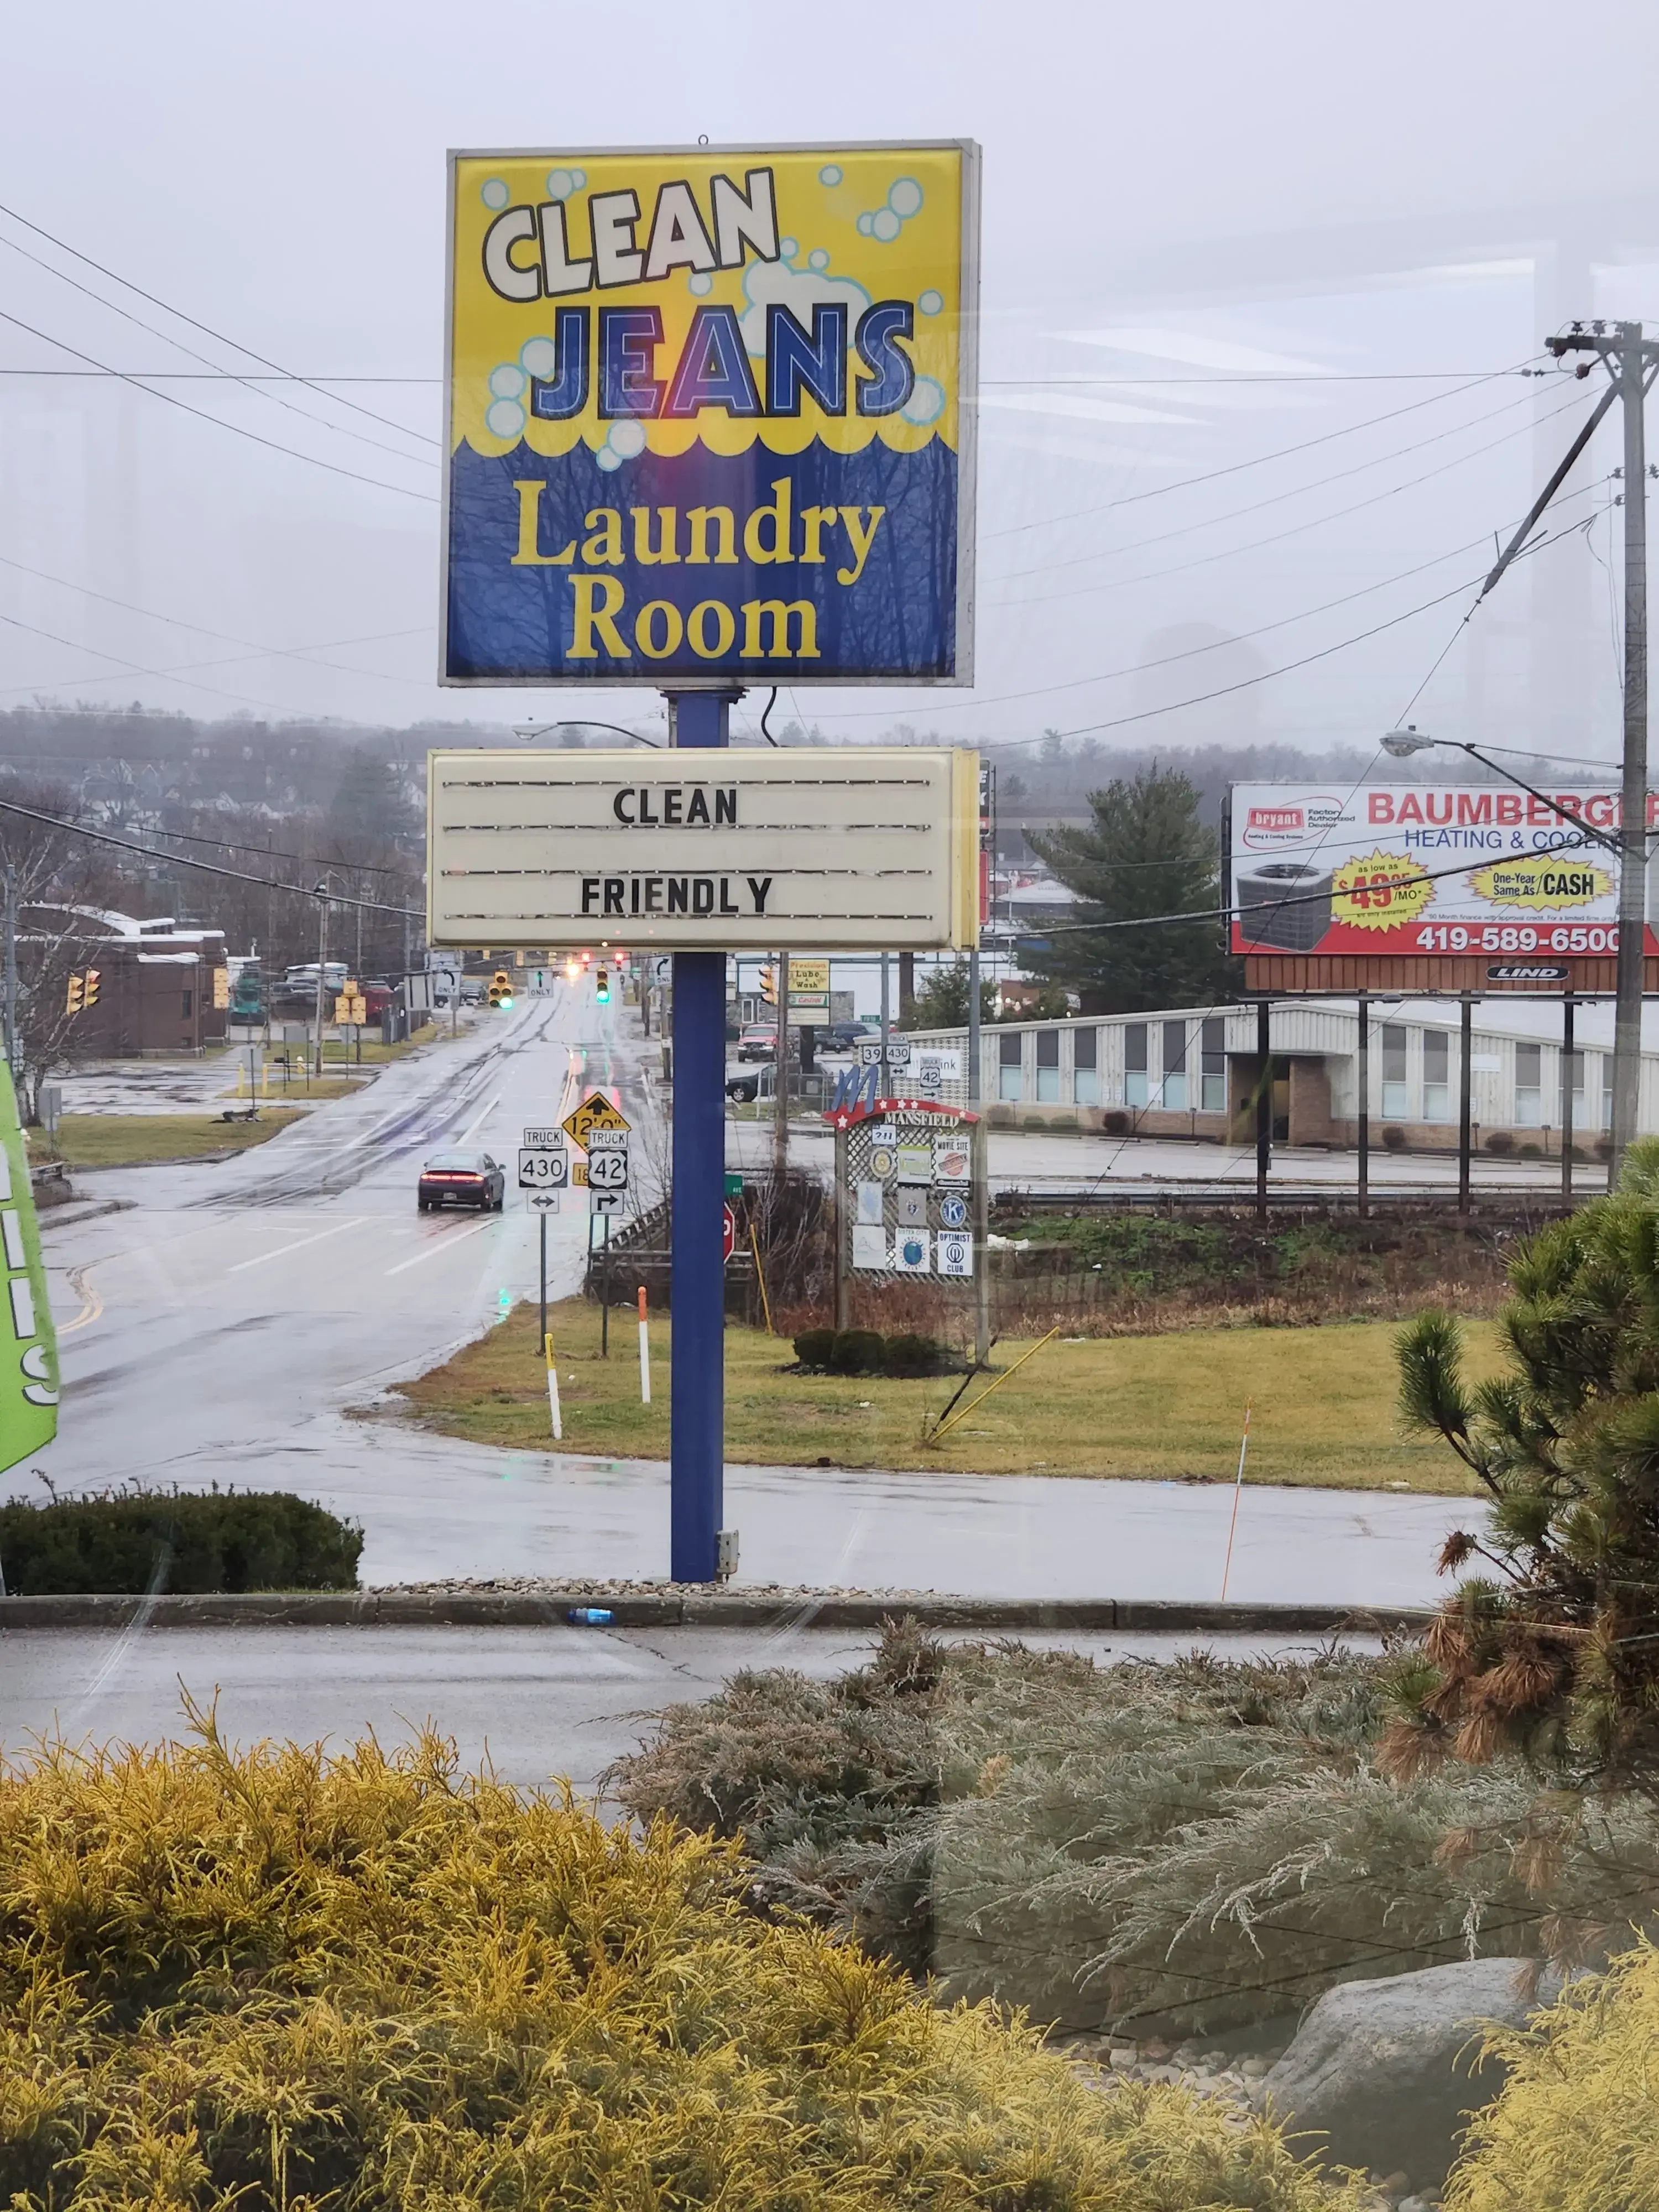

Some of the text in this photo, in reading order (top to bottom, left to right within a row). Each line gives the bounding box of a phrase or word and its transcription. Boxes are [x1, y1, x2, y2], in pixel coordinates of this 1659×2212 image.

[482, 166, 781, 302] CLEAN
[530, 300, 915, 420] JEANS
[510, 476, 885, 586] Laundry
[566, 573, 822, 659] Room
[613, 788, 738, 825] CLEAN
[1255, 812, 1298, 827] bryant
[1405, 830, 1502, 849] HEATING
[1510, 831, 1524, 849] &
[1493, 872, 1535, 884] One-Year
[581, 877, 773, 915] FRIENDLY
[1494, 885, 1535, 895] Same As
[1416, 926, 1619, 952] 419-589-6500
[1496, 967, 1559, 977] LIND
[864, 1049, 881, 1060] 39
[888, 1048, 908, 1058] 430
[922, 1072, 938, 1083] 42
[832, 1065, 879, 1114] M
[884, 1112, 959, 1127] MANSFIELD
[526, 1132, 560, 1142] TRUCK
[592, 1133, 625, 1144] TRUCK
[937, 1141, 968, 1151] MOVIE SITE
[522, 1159, 562, 1177] 430
[594, 1159, 622, 1179] 42
[940, 1233, 971, 1243] OPTIMIST
[947, 1264, 964, 1273] CLUB
